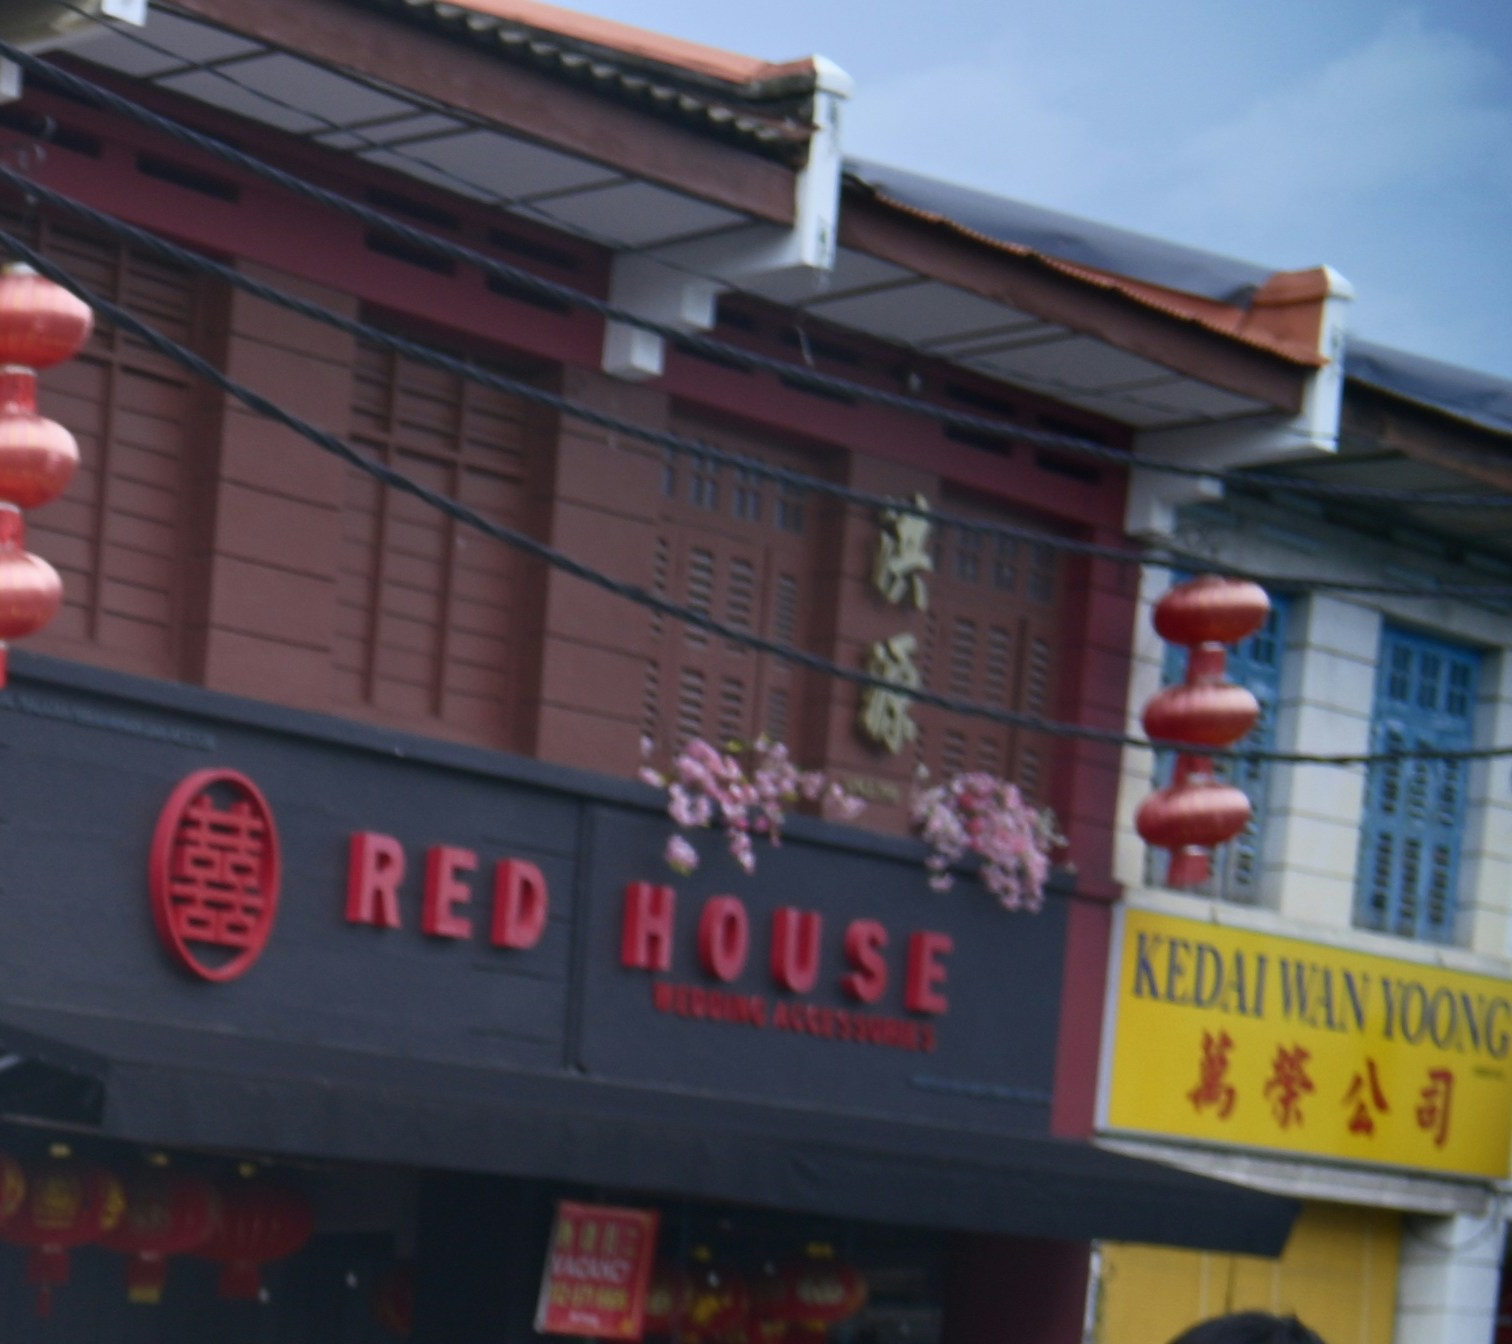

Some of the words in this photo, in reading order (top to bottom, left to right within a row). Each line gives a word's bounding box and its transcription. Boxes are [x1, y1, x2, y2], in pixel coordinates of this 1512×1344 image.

[344, 830, 551, 951] RED
[620, 880, 956, 1015] HOUSE
[1131, 929, 1268, 1020] KEDAI
[1280, 957, 1367, 1035] WAN
[1380, 976, 1511, 1060] YOONG
